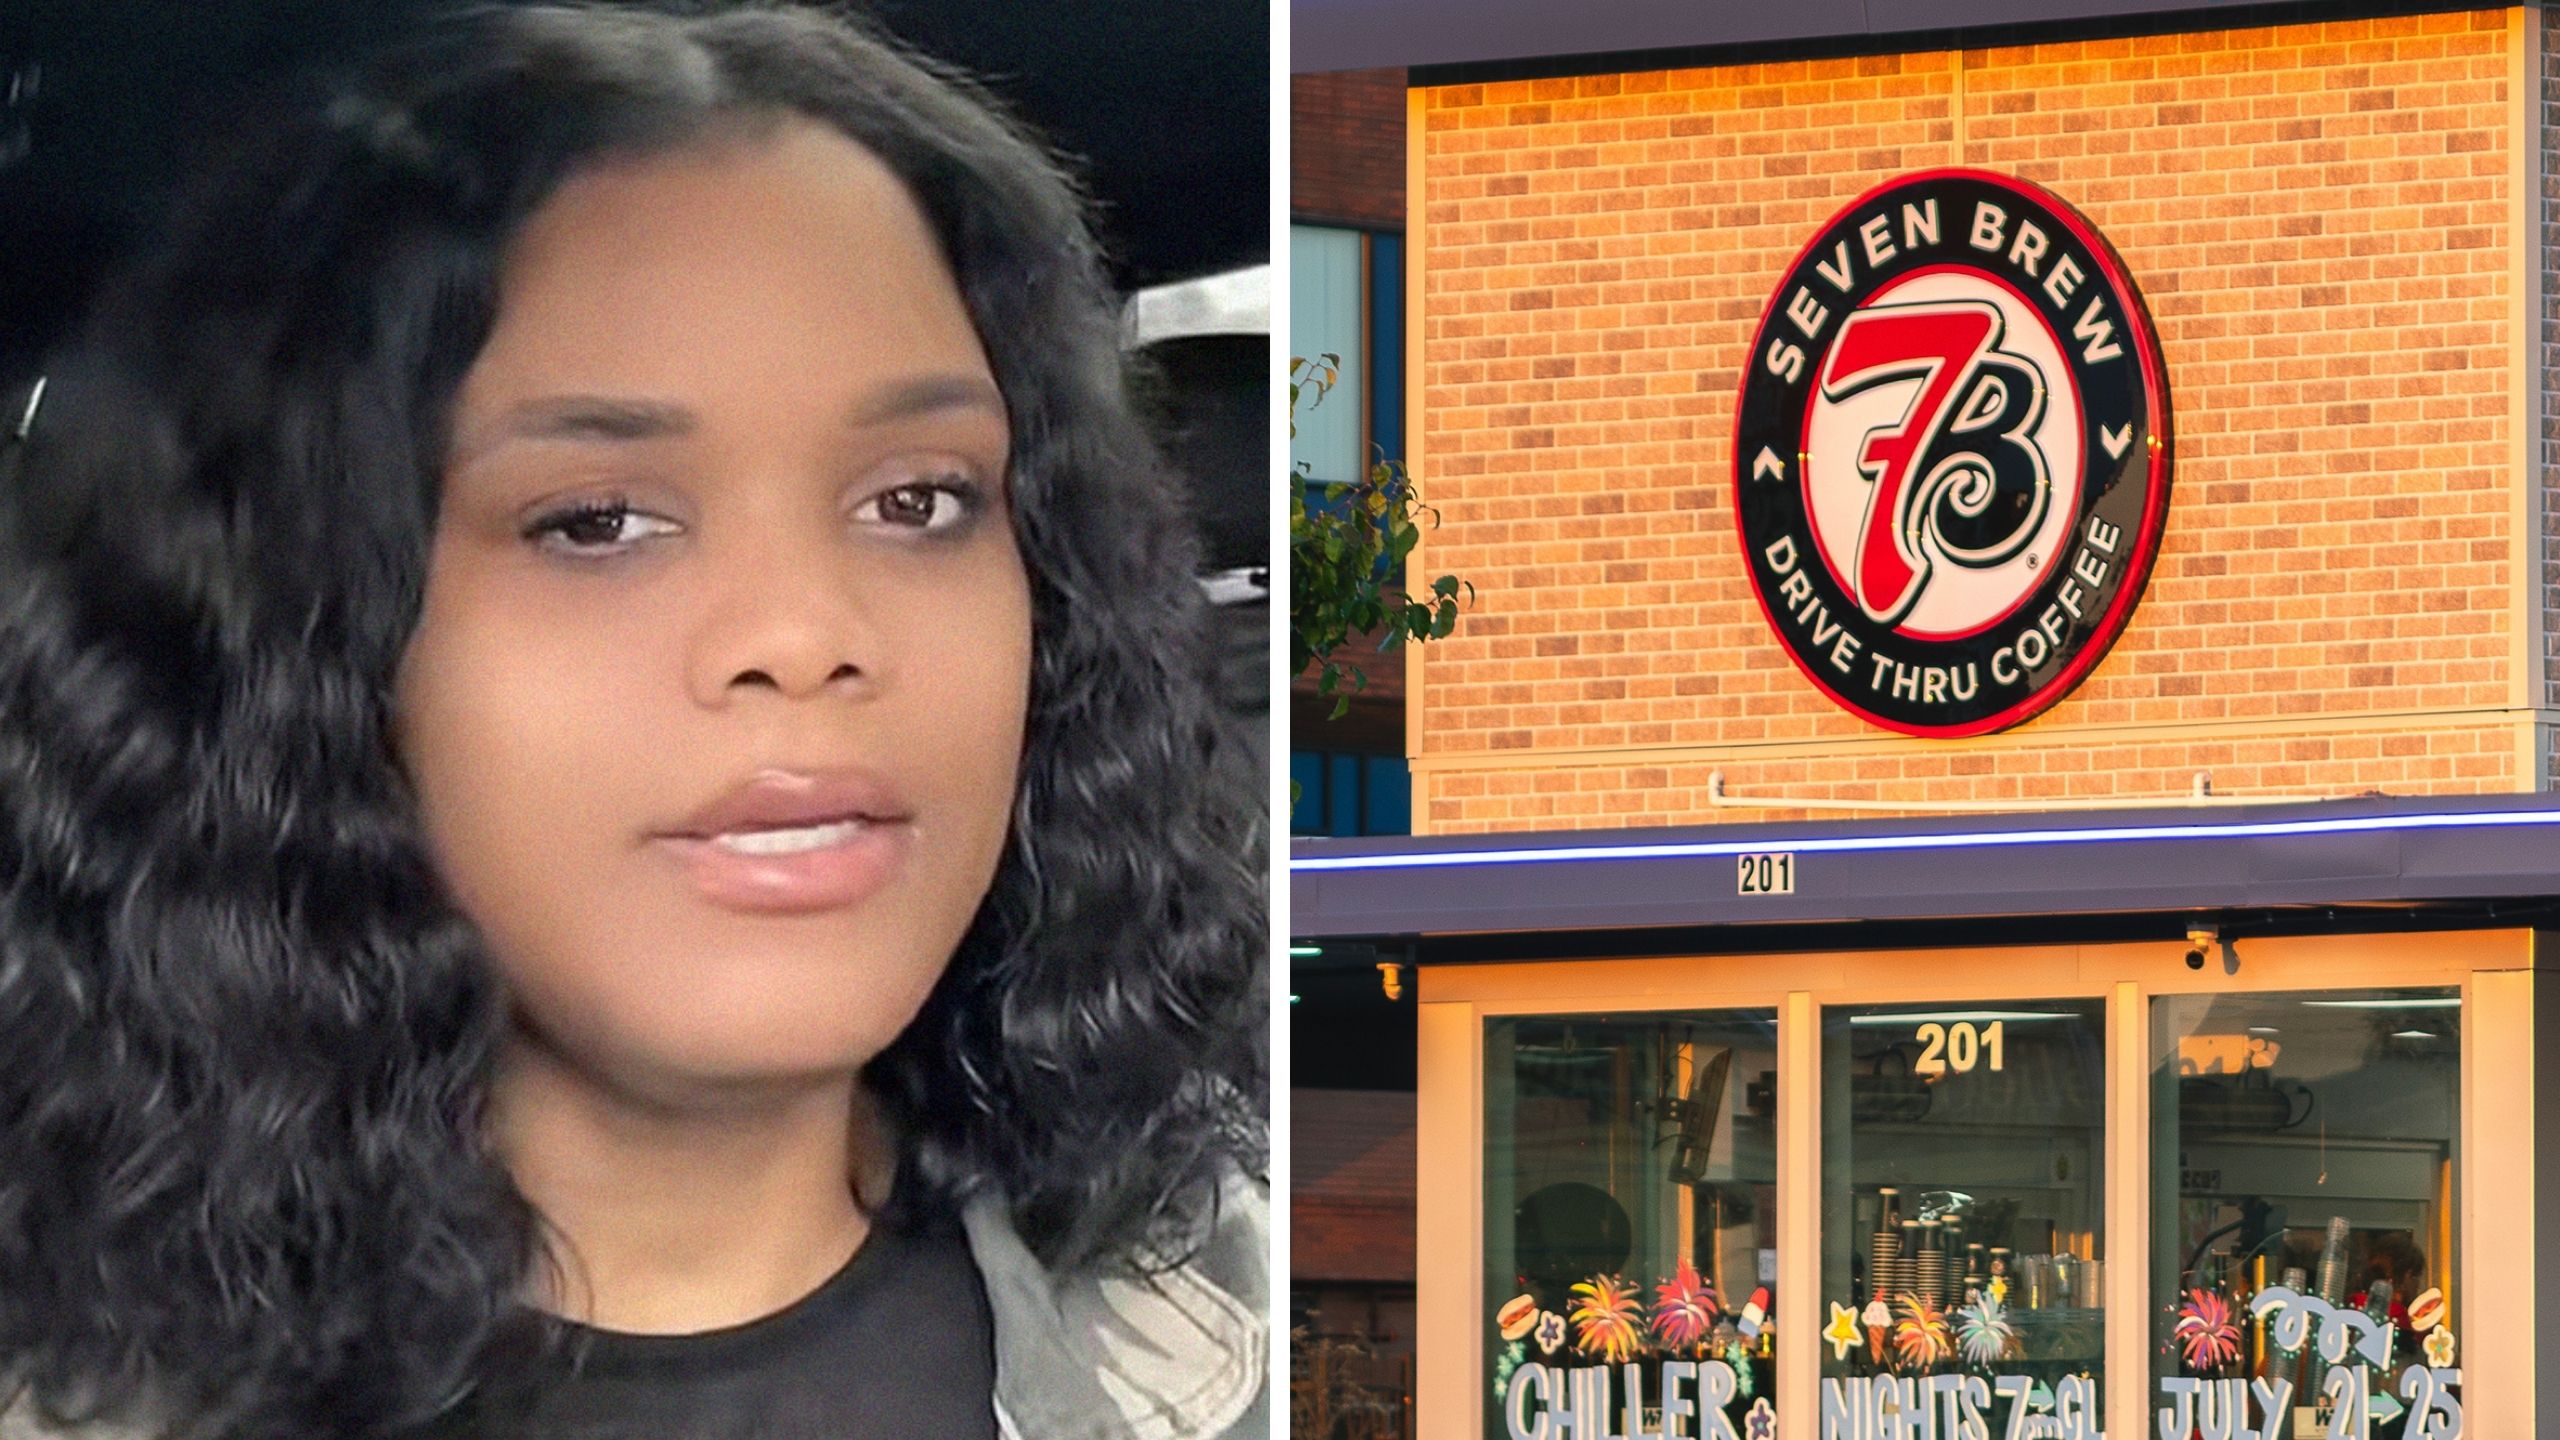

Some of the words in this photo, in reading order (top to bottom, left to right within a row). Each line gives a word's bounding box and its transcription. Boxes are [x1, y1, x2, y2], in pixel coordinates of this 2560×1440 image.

[1766, 198, 1941, 383] SEVEN
[1969, 200, 2124, 366] BREW
[1820, 299, 2054, 624] 7B
[1765, 534, 1863, 674] DRIVE
[1870, 650, 1978, 703] THRU
[1990, 513, 2122, 686] COFFEE
[1740, 854, 1791, 893] 201
[1914, 1020, 2004, 1073] 201
[1505, 1360, 1741, 1440] CHILLER
[1821, 1373, 1992, 1440] NIGHTS
[2158, 1375, 2294, 1440] JULY
[2322, 1364, 2371, 1440] 21
[2400, 1363, 2464, 1440] 25
